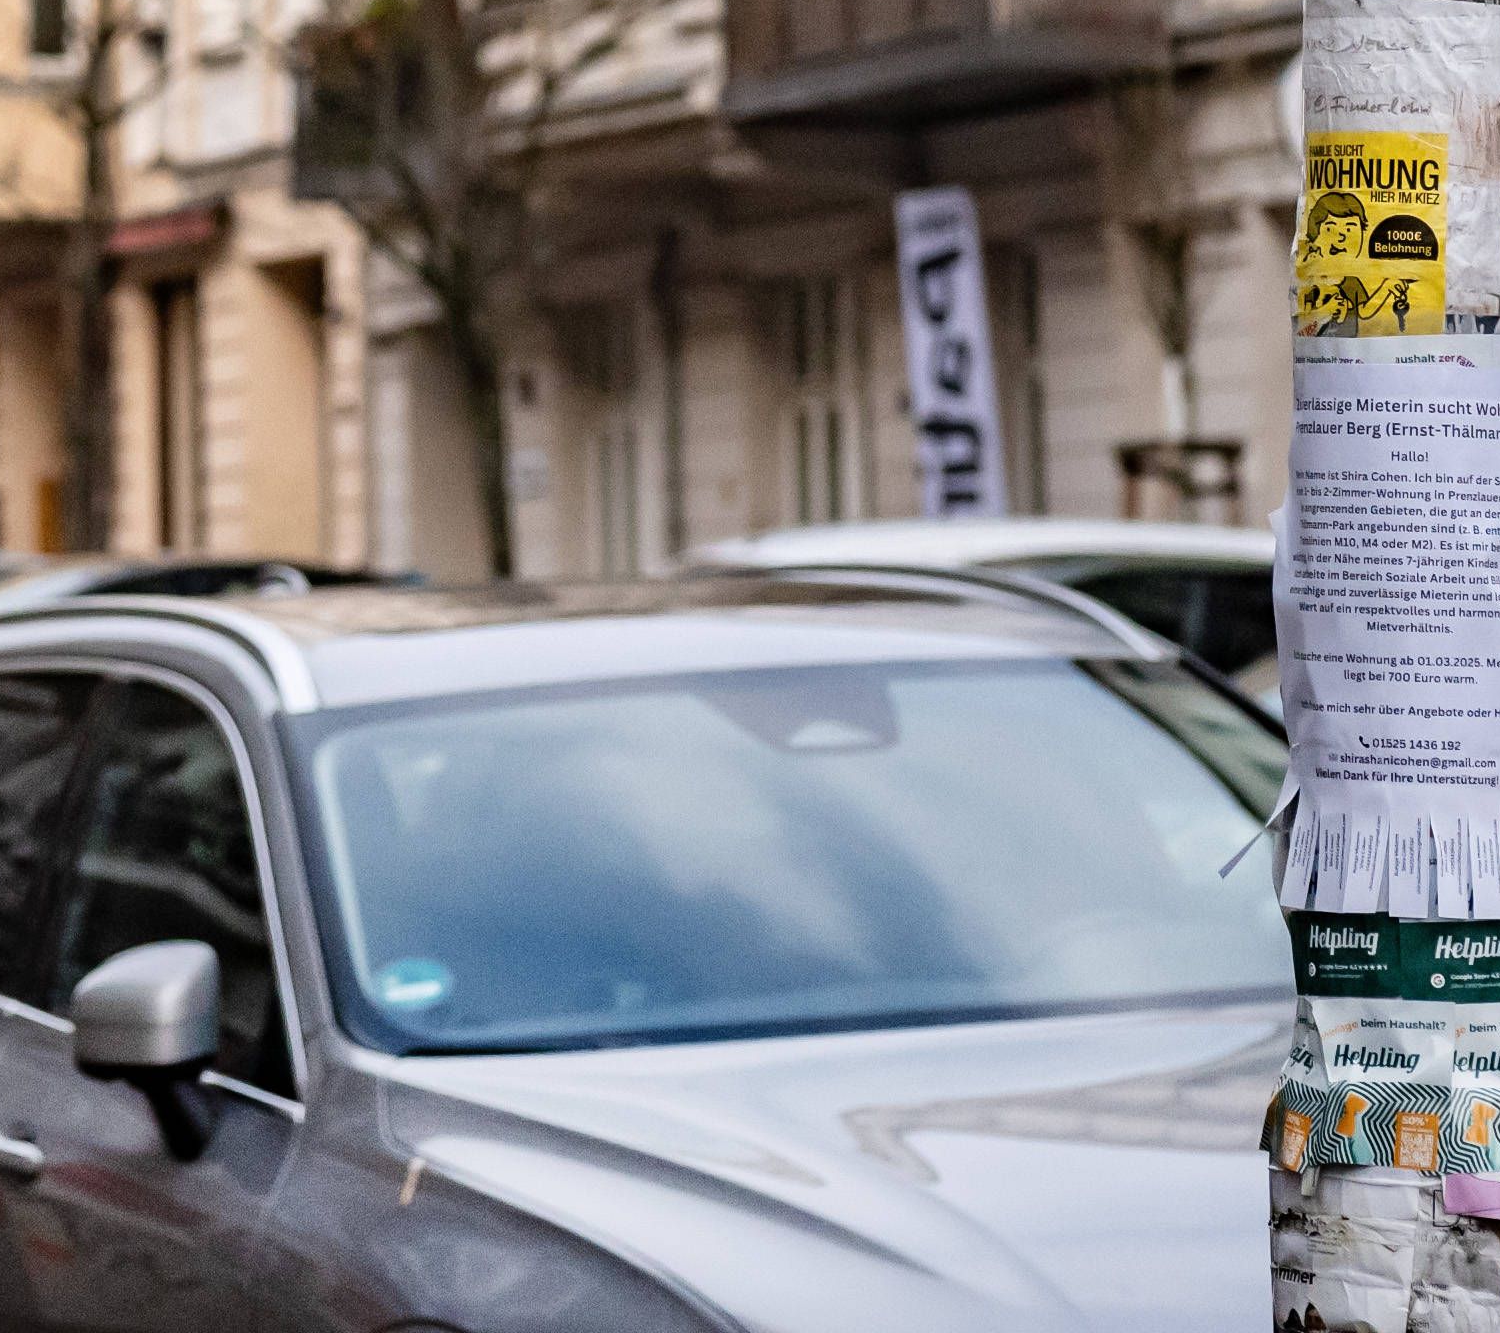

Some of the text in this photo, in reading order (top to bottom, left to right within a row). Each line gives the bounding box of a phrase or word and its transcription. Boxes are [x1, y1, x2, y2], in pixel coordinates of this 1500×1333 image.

[1334, 144, 1365, 157] SUCHT
[1309, 158, 1439, 191] WOHNUNG
[1370, 190, 1440, 205] HIER IM KIEZ
[1387, 230, 1423, 241] 1000€
[1374, 242, 1432, 256] Belohnung
[1356, 398, 1423, 413] Mieterin
[1428, 400, 1473, 415] sucht
[1346, 421, 1382, 439] Berg
[1390, 451, 1429, 462] Hallo!
[1327, 470, 1340, 481] ist
[1341, 471, 1369, 481] Shira
[1371, 471, 1412, 483] Cohen.
[1414, 473, 1432, 483] Ich
[1435, 473, 1454, 484] bin
[1456, 474, 1475, 484] auf
[1475, 475, 1493, 486] der
[1310, 487, 1322, 496] bis
[1323, 487, 1432, 502] 2-Zimmer-Wohnung
[1434, 490, 1445, 500] in
[1370, 505, 1426, 517] Gebieten,
[1429, 506, 1448, 517] die
[1450, 508, 1468, 520] gut
[1469, 510, 1482, 518] an
[1357, 522, 1428, 534] angebunden
[1431, 523, 1456, 534] sind
[1473, 525, 1483, 535] B.
[1334, 537, 1360, 549] M10,
[1361, 538, 1379, 548] M4
[1381, 539, 1408, 549] oder
[1411, 539, 1436, 550] M2).
[1440, 540, 1453, 551] Es
[1455, 541, 1470, 551] ist
[1472, 542, 1489, 552] mir
[1316, 553, 1332, 563] der
[1334, 553, 1361, 564] Nähe
[1363, 556, 1404, 566] meines
[1407, 556, 1464, 570] 7-jährigen
[1467, 558, 1498, 569] Kindes
[1328, 570, 1340, 581] im
[1342, 570, 1383, 582] Bereich
[1385, 572, 1427, 583] Soziale
[1430, 573, 1466, 584] Arbeit
[1468, 575, 1489, 585] und
[1327, 587, 1346, 597] und
[1348, 588, 1418, 602] zuverlässige
[1420, 590, 1469, 601] Mieterin
[1471, 592, 1493, 602] und
[1299, 601, 1318, 613] Wert
[1319, 602, 1334, 613] auf
[1336, 604, 1352, 614] ein
[1354, 604, 1430, 617] respektvolles
[1433, 607, 1456, 618] und
[1366, 621, 1454, 633] Mietverhältnis.
[1323, 653, 1344, 663] eine
[1346, 653, 1398, 668] Wohnung
[1399, 655, 1414, 666] ab
[1417, 656, 1484, 668] 01.03.2025.
[1343, 670, 1478, 685] liegt bei 700 Euro warm.
[1326, 702, 1351, 713] mich
[1353, 703, 1376, 714] sehr
[1378, 704, 1405, 715] über
[1407, 706, 1464, 719] Angebote
[1466, 707, 1492, 718] oder
[1372, 738, 1407, 749] 01525
[1441, 740, 1461, 751] 192
[1315, 767, 1499, 788] Vielen Dank für Ihre Unterstützung!
[1309, 924, 1379, 956] Helpling
[1360, 1018, 1387, 1030] beim
[1389, 1019, 1447, 1031] Haushalt?
[1469, 1023, 1497, 1033] beim
[1333, 1044, 1421, 1074] Helpling
